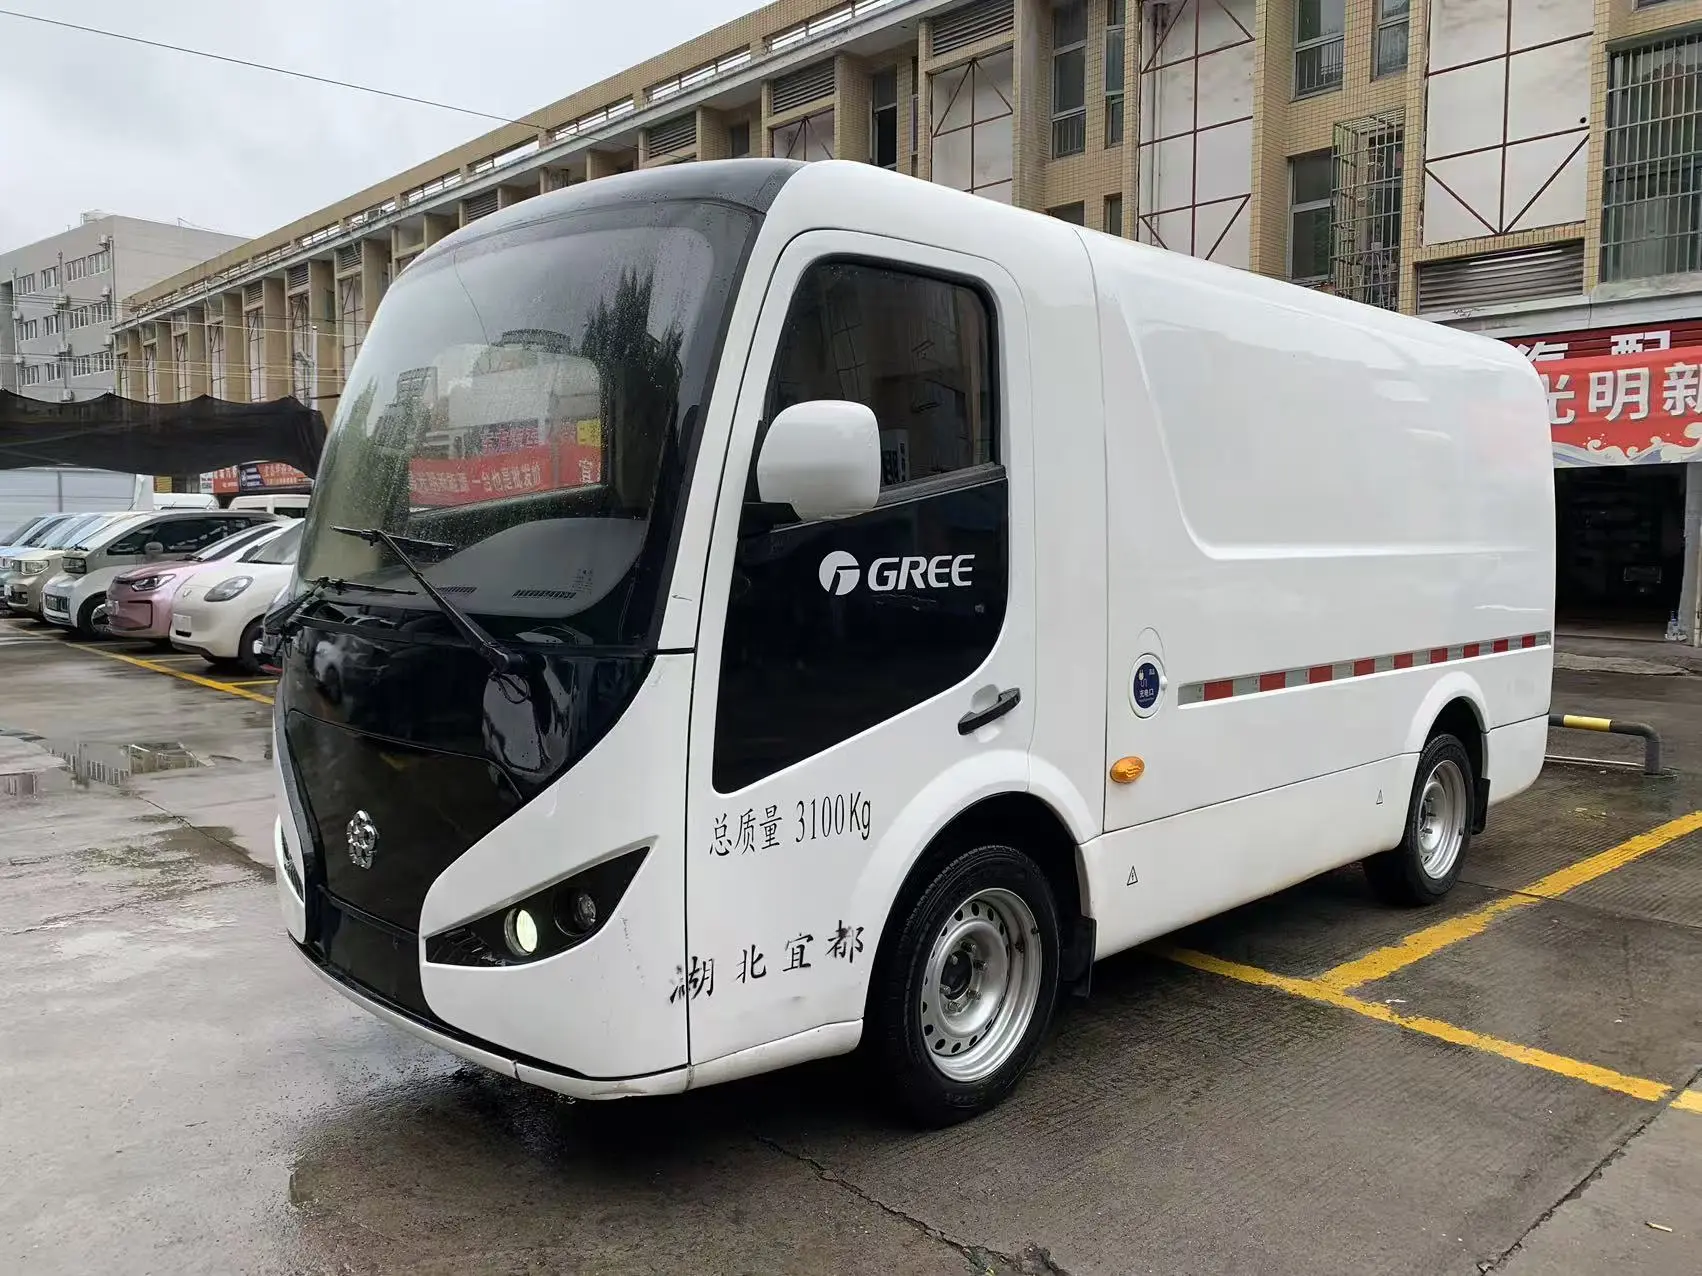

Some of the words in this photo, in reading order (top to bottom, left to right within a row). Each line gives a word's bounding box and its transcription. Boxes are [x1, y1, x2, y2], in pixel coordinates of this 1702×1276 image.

[867, 554, 976, 591] GREE
[709, 804, 783, 857] 总质量
[794, 791, 872, 842] 3100Kg
[669, 919, 865, 1004] 湖北宜都
